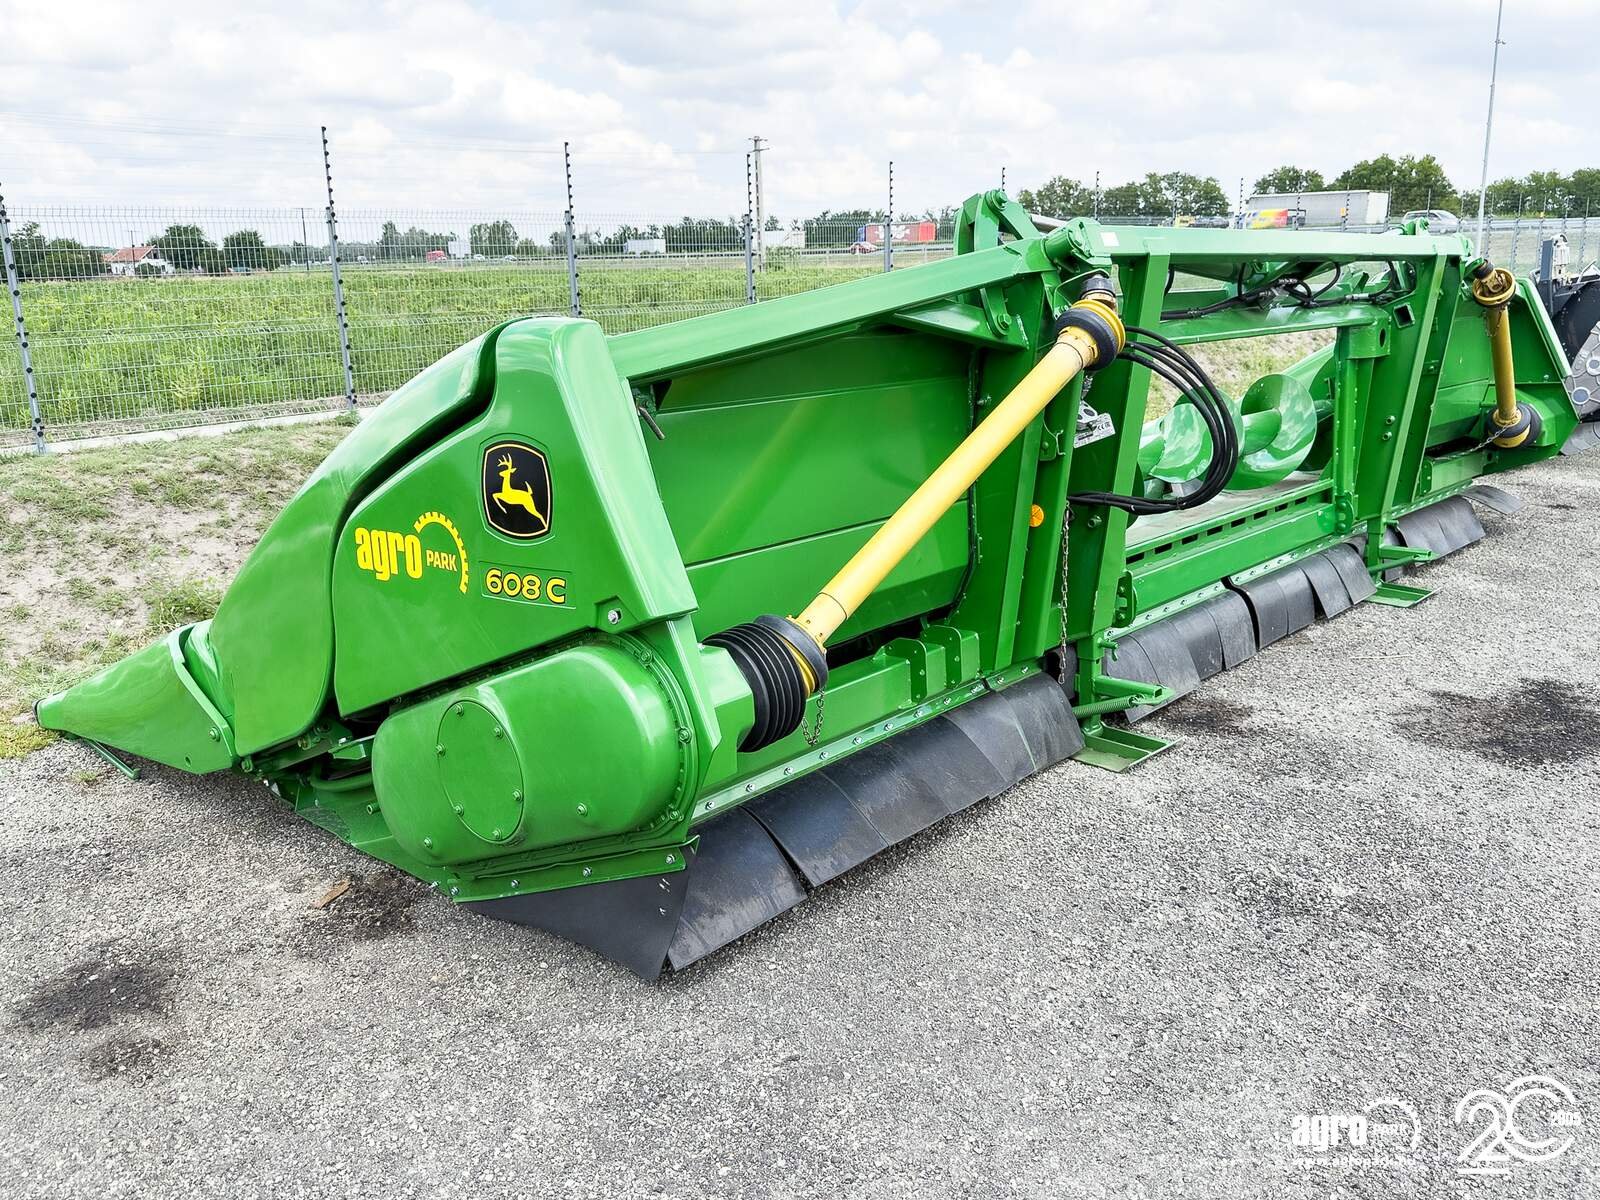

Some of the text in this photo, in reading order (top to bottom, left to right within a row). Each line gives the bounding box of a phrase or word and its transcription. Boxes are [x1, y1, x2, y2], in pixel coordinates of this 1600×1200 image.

[355, 527, 457, 581] agro PARK
[485, 568, 566, 604] 608 C
